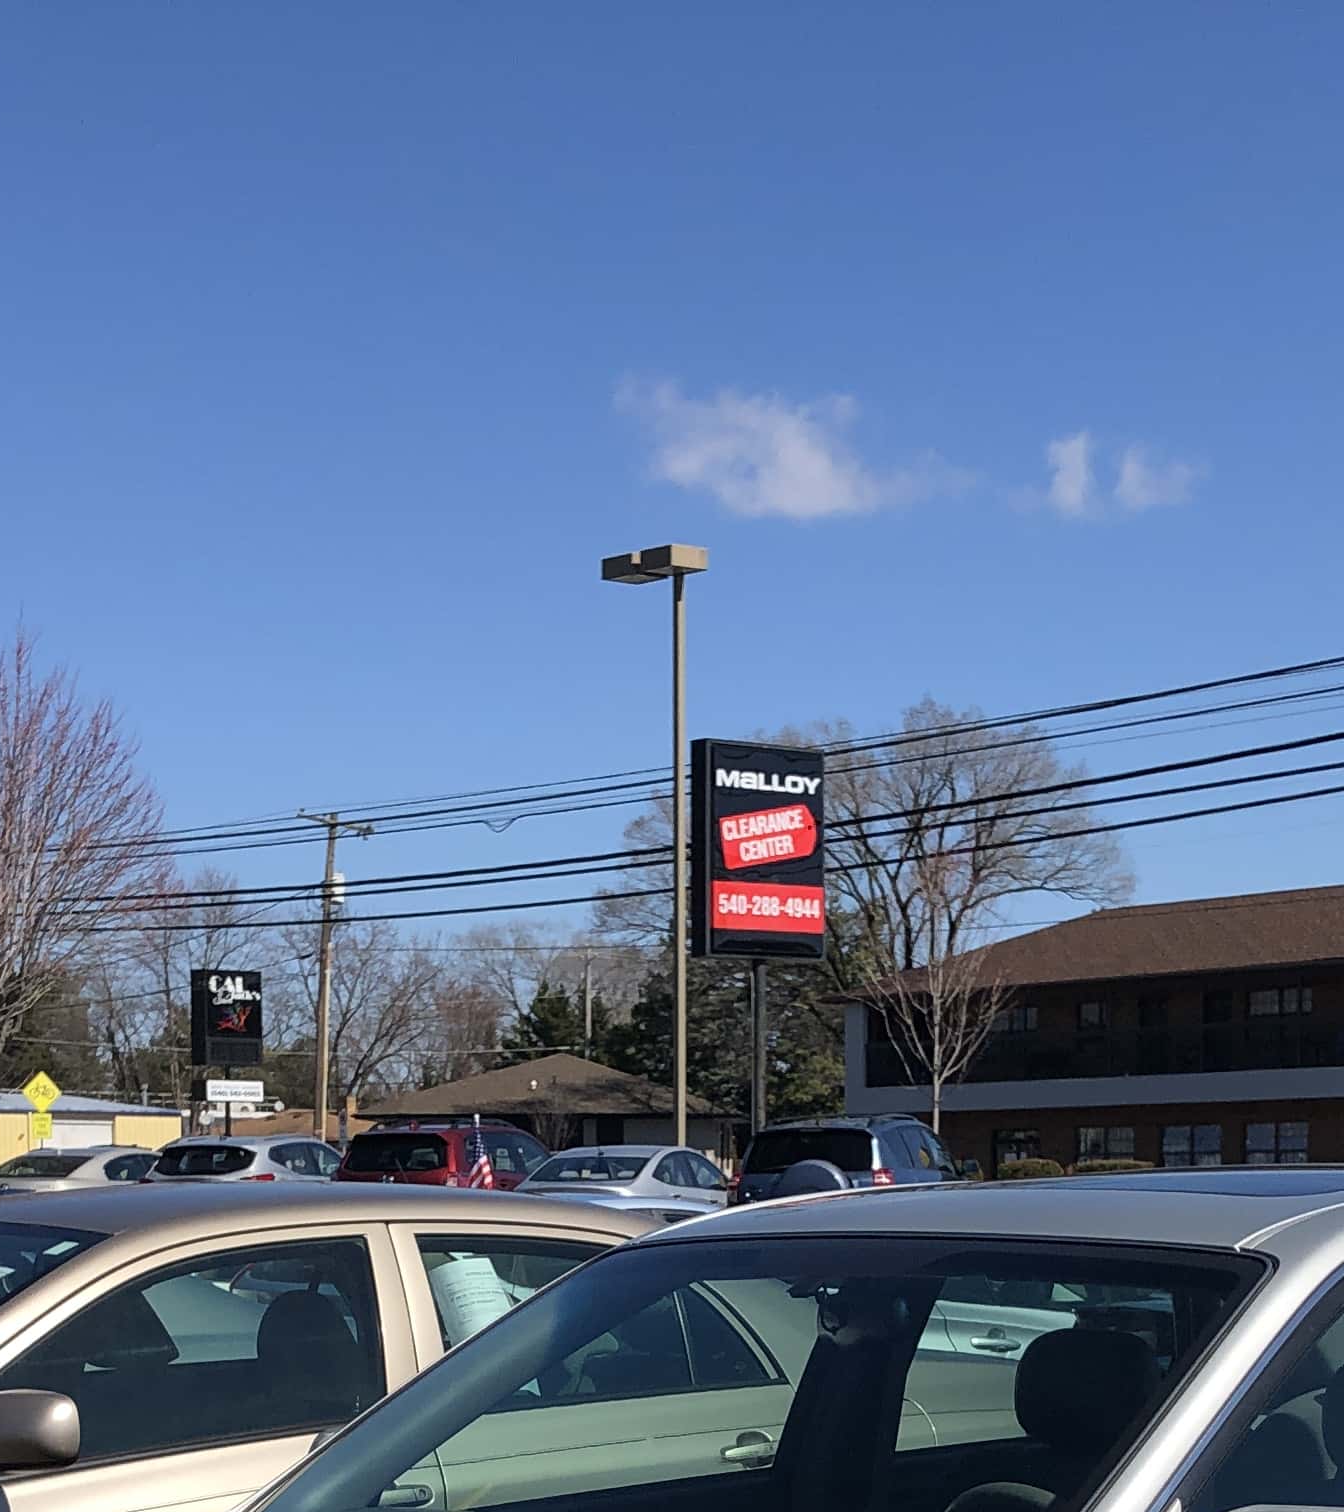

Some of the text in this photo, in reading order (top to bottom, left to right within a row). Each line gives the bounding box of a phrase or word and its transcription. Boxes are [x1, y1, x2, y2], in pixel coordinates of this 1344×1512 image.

[721, 809, 805, 842] CLEARANCE
[739, 835, 795, 863] CENTER
[718, 893, 821, 919] 540-288-4944
